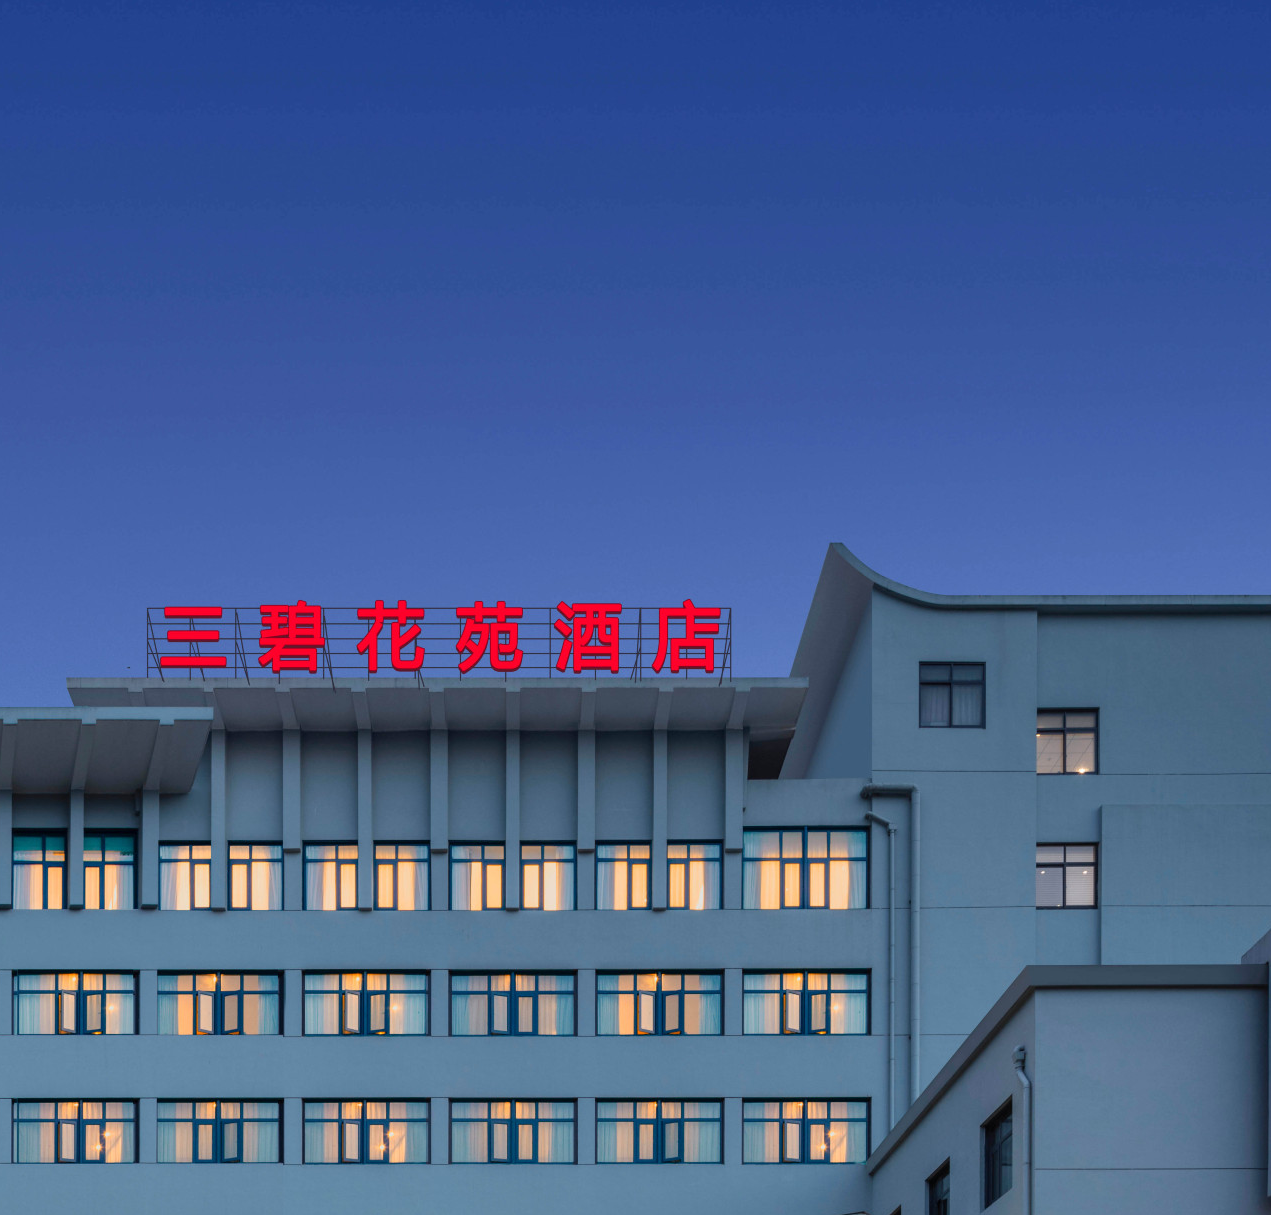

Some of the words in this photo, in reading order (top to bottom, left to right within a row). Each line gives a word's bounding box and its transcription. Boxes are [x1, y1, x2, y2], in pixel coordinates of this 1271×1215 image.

[159, 598, 722, 673] 三碧花苑酒店
